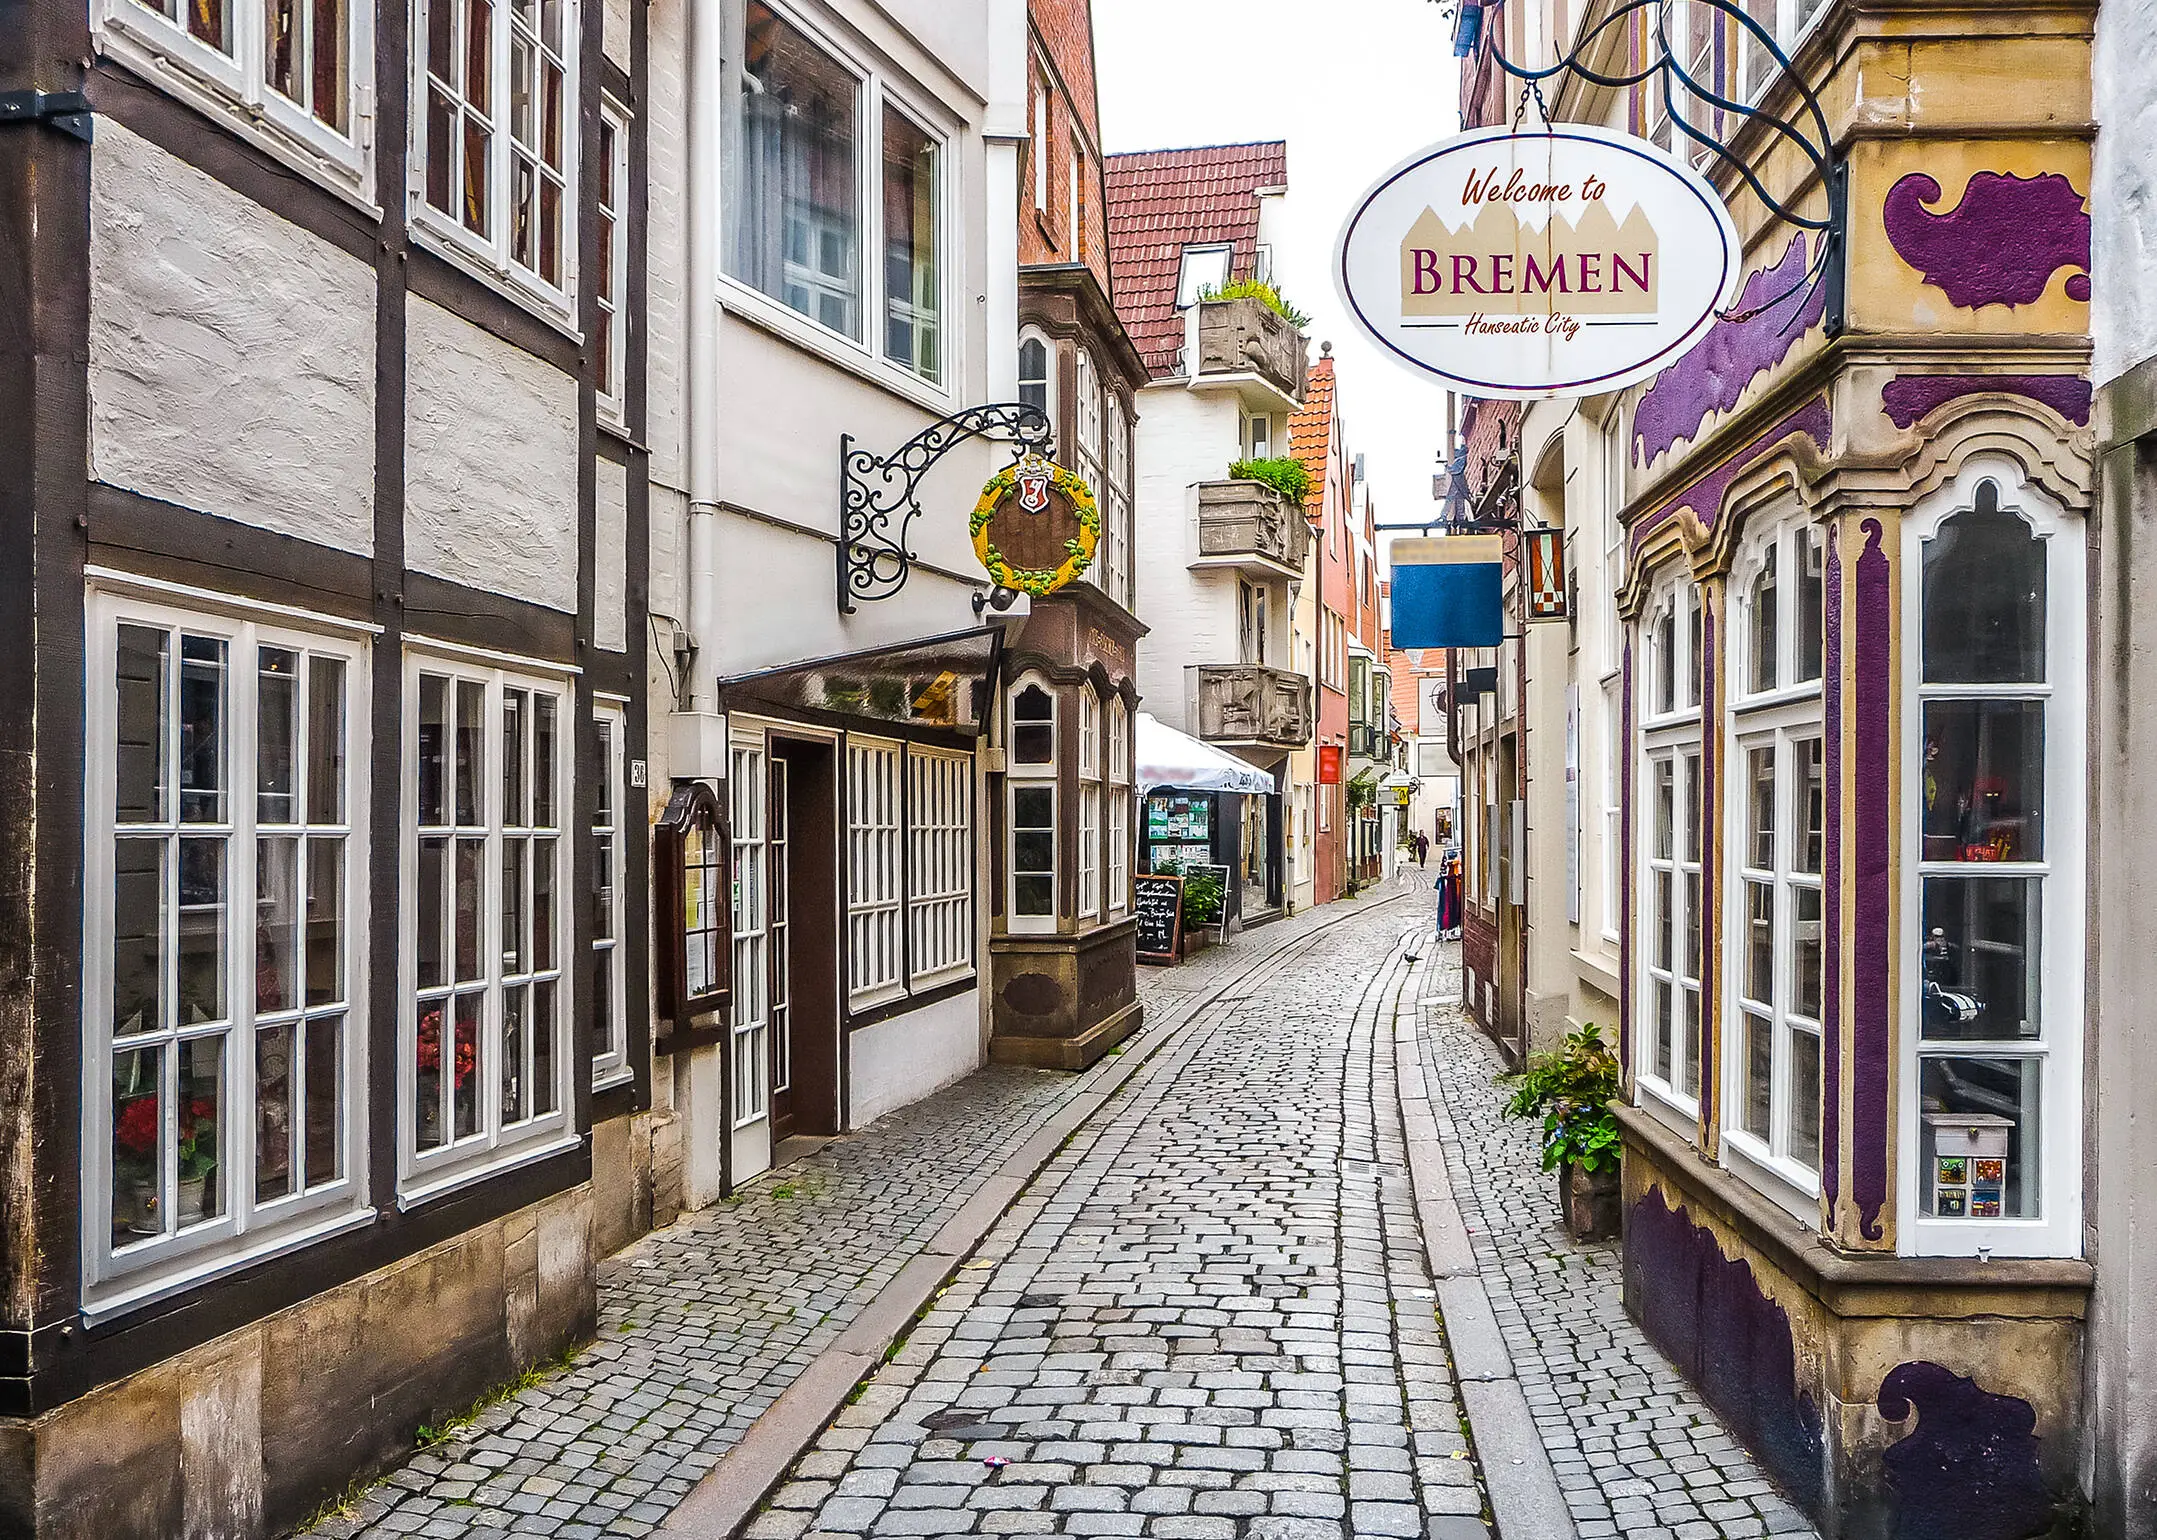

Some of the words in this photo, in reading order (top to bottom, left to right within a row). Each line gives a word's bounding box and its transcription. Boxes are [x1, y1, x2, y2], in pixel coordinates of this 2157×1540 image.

[1461, 166, 1573, 206] Welcome
[1581, 174, 1606, 201] to
[1410, 248, 1653, 295] BREMEN
[1464, 312, 1540, 335] Hanseatic
[1545, 311, 1581, 341] City
